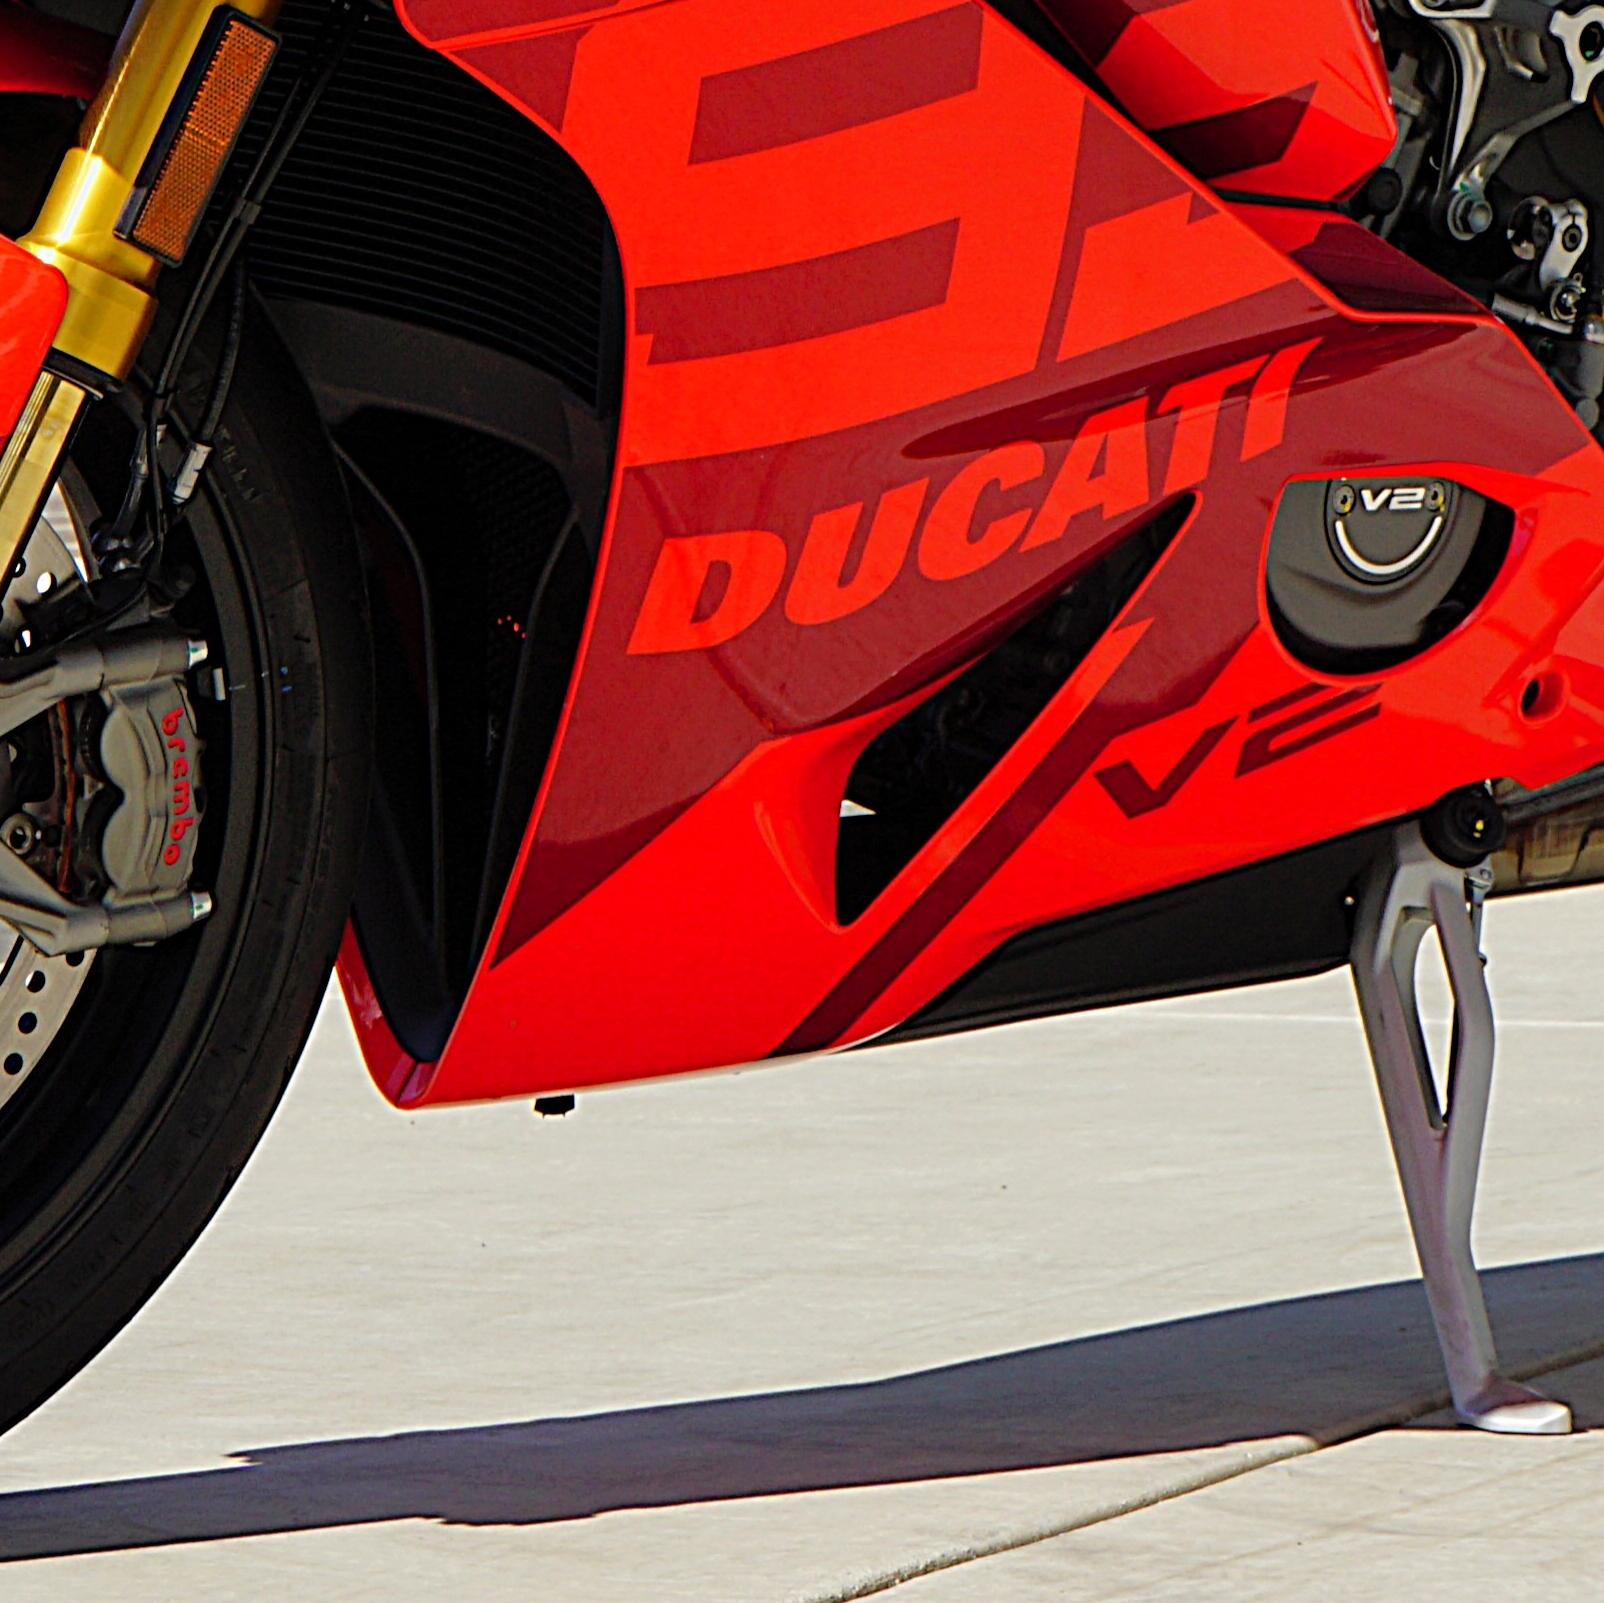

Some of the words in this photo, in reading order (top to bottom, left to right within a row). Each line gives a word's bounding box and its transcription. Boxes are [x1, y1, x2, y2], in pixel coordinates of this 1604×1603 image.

[626, 336, 1324, 656] DUCATI
[1359, 487, 1426, 511] V2
[162, 707, 195, 866] brembo
[1094, 684, 1383, 821] V2
